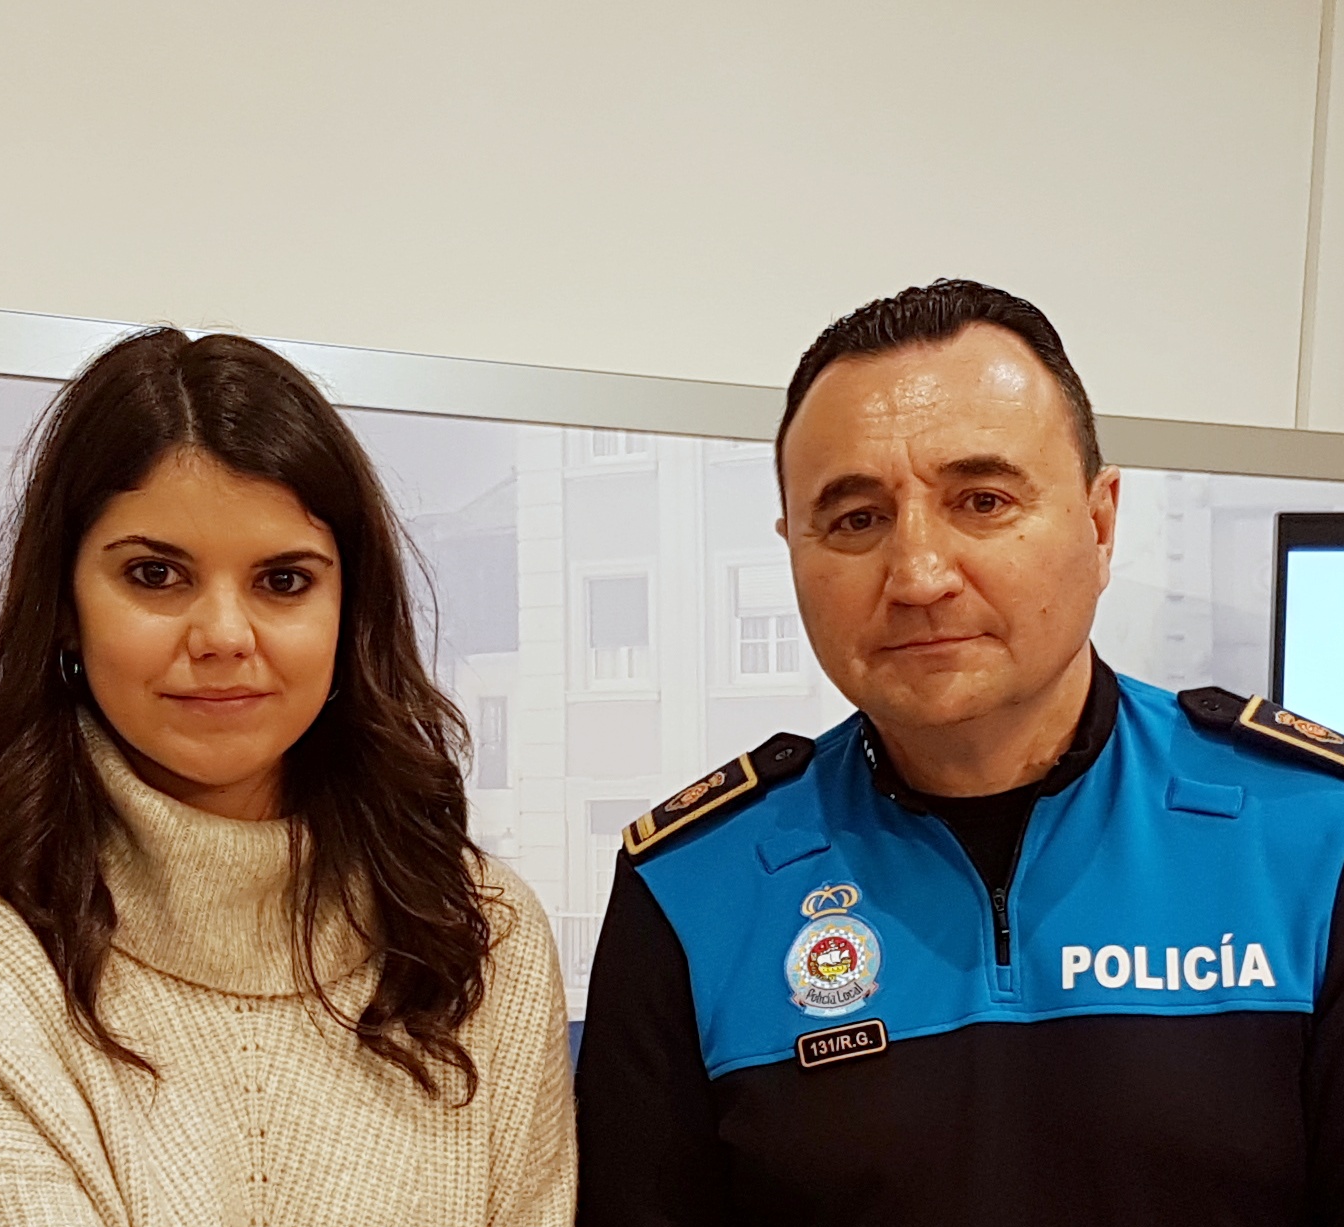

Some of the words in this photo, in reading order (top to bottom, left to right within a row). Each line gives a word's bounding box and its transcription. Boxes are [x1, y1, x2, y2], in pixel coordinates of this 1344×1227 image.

[1061, 933, 1276, 991] POLICÍA
[805, 988, 836, 1005] Policía
[837, 981, 863, 1003] Local
[810, 1031, 874, 1057] 131/R.G.
